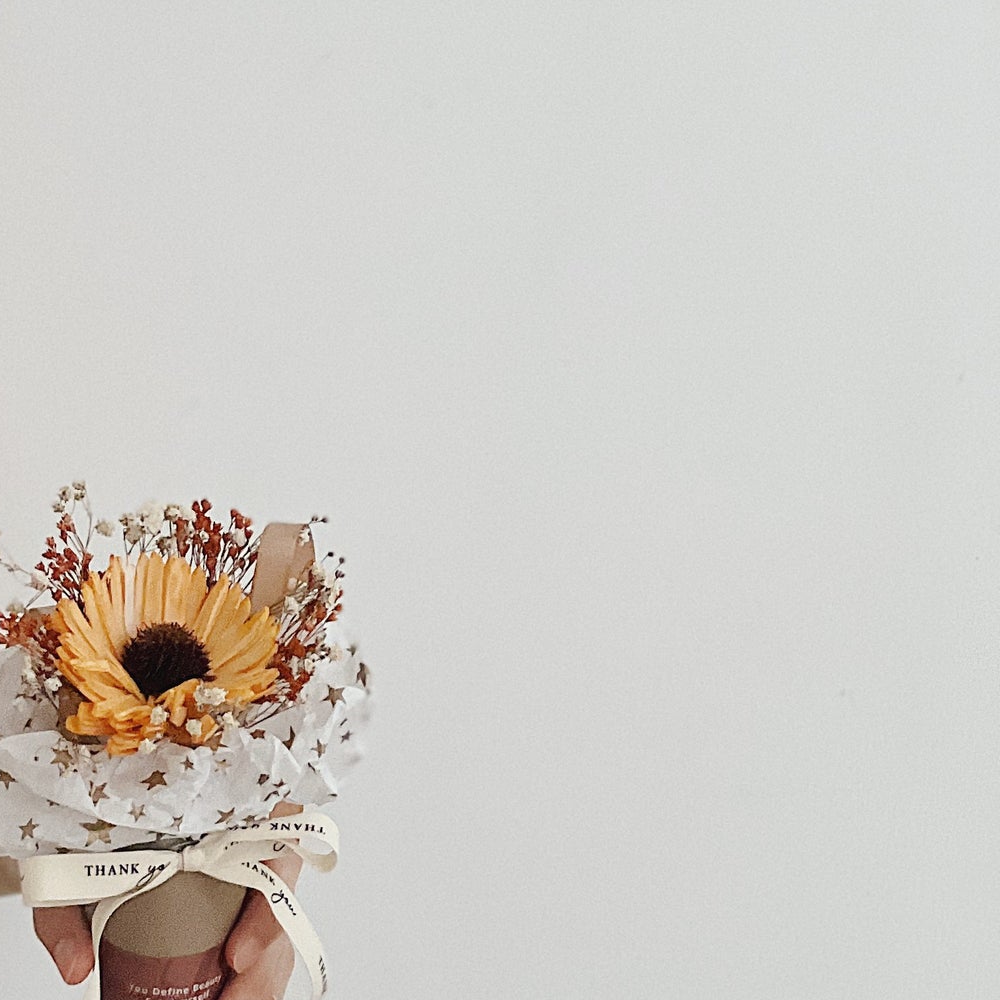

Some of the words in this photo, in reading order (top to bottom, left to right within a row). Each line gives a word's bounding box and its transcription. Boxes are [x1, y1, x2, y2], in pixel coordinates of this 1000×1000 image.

[269, 823, 326, 835] THANK
[84, 863, 140, 877] THANK
[129, 983, 149, 995] You
[152, 986, 190, 996] Define
